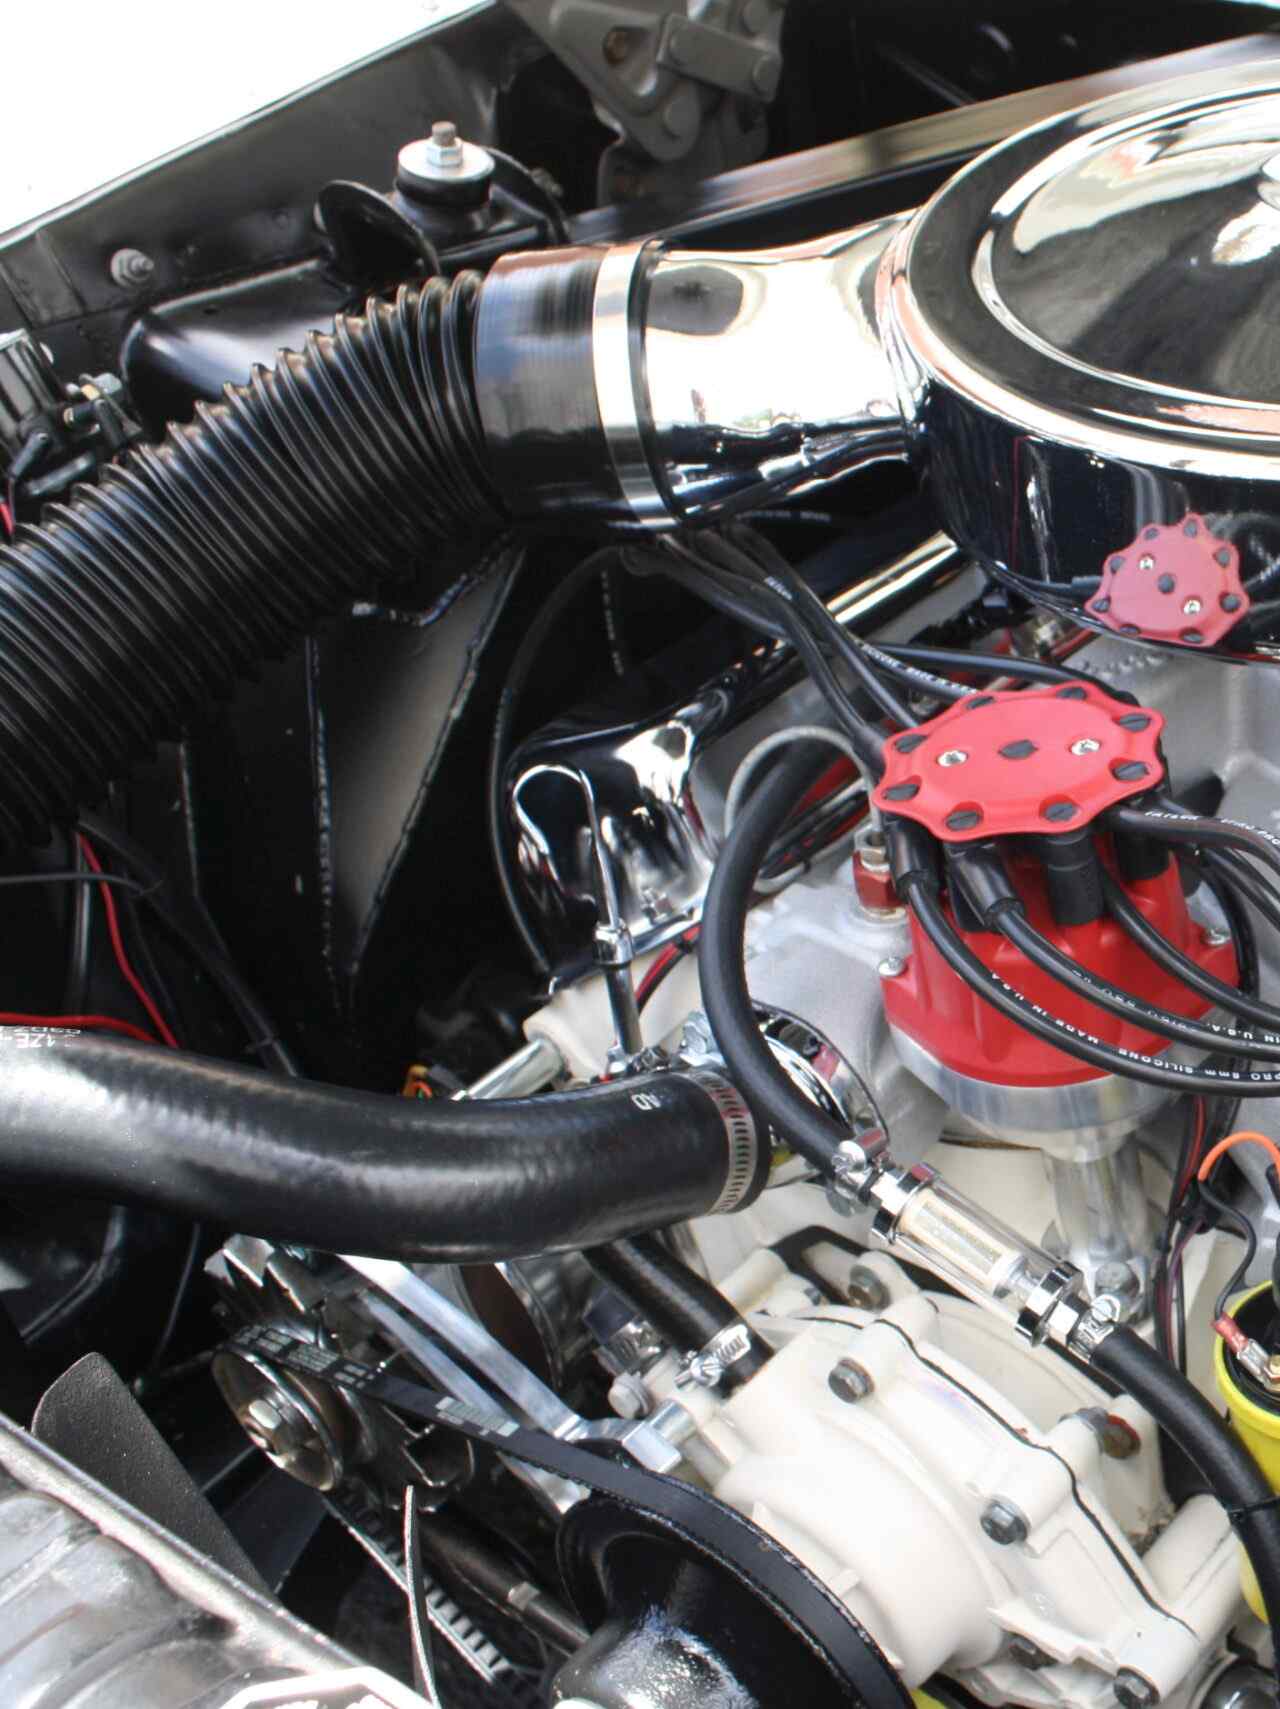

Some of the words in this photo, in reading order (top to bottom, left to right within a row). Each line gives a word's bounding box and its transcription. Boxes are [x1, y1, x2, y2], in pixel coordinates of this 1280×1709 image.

[1032, 1004, 1047, 1017] IN
[1055, 1019, 1099, 1045] MADE
[1264, 1035, 1280, 1044] IN
[1118, 1047, 1194, 1074] SILICONE
